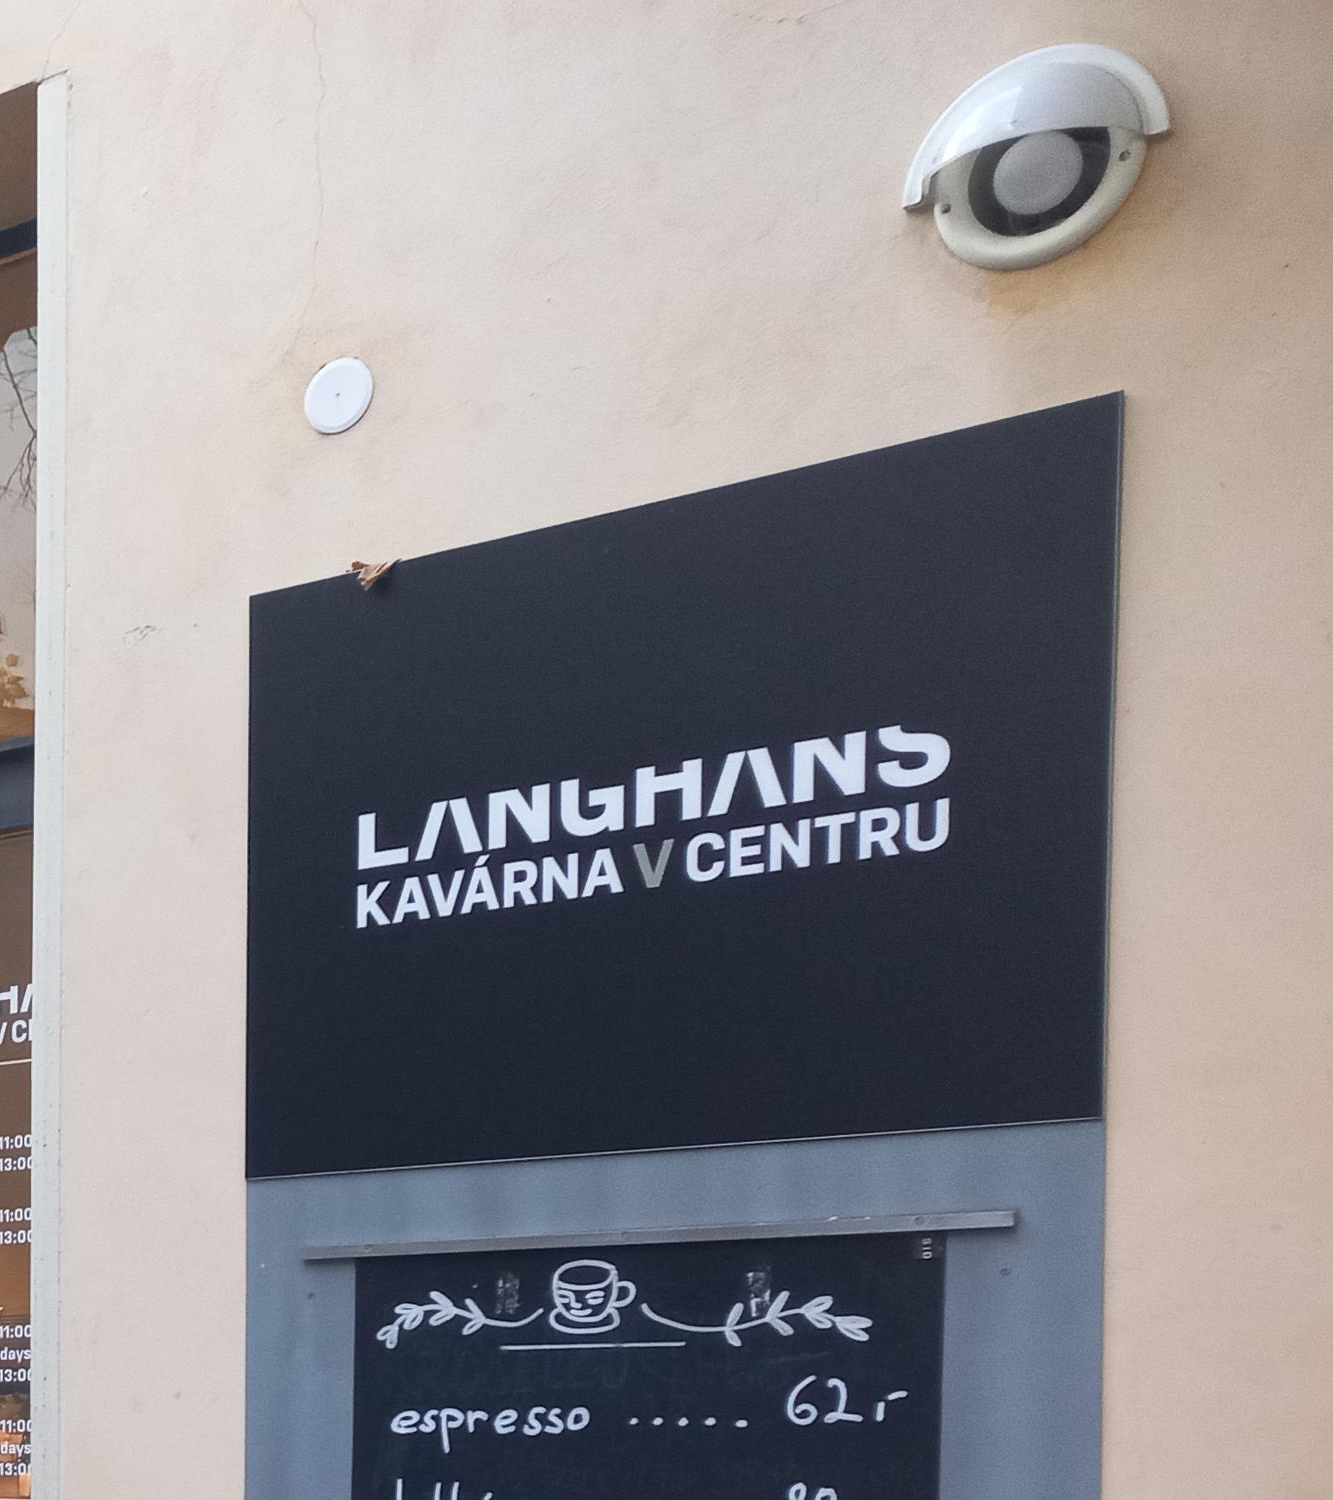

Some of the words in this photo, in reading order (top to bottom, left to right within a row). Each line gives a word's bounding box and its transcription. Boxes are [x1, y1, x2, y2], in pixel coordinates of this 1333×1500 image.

[356, 854, 624, 928] KAVÁRNA
[633, 838, 674, 889] V
[685, 797, 951, 883] CENTRU
[357, 725, 951, 870] LANGHANS
[390, 1406, 590, 1454] espresso
